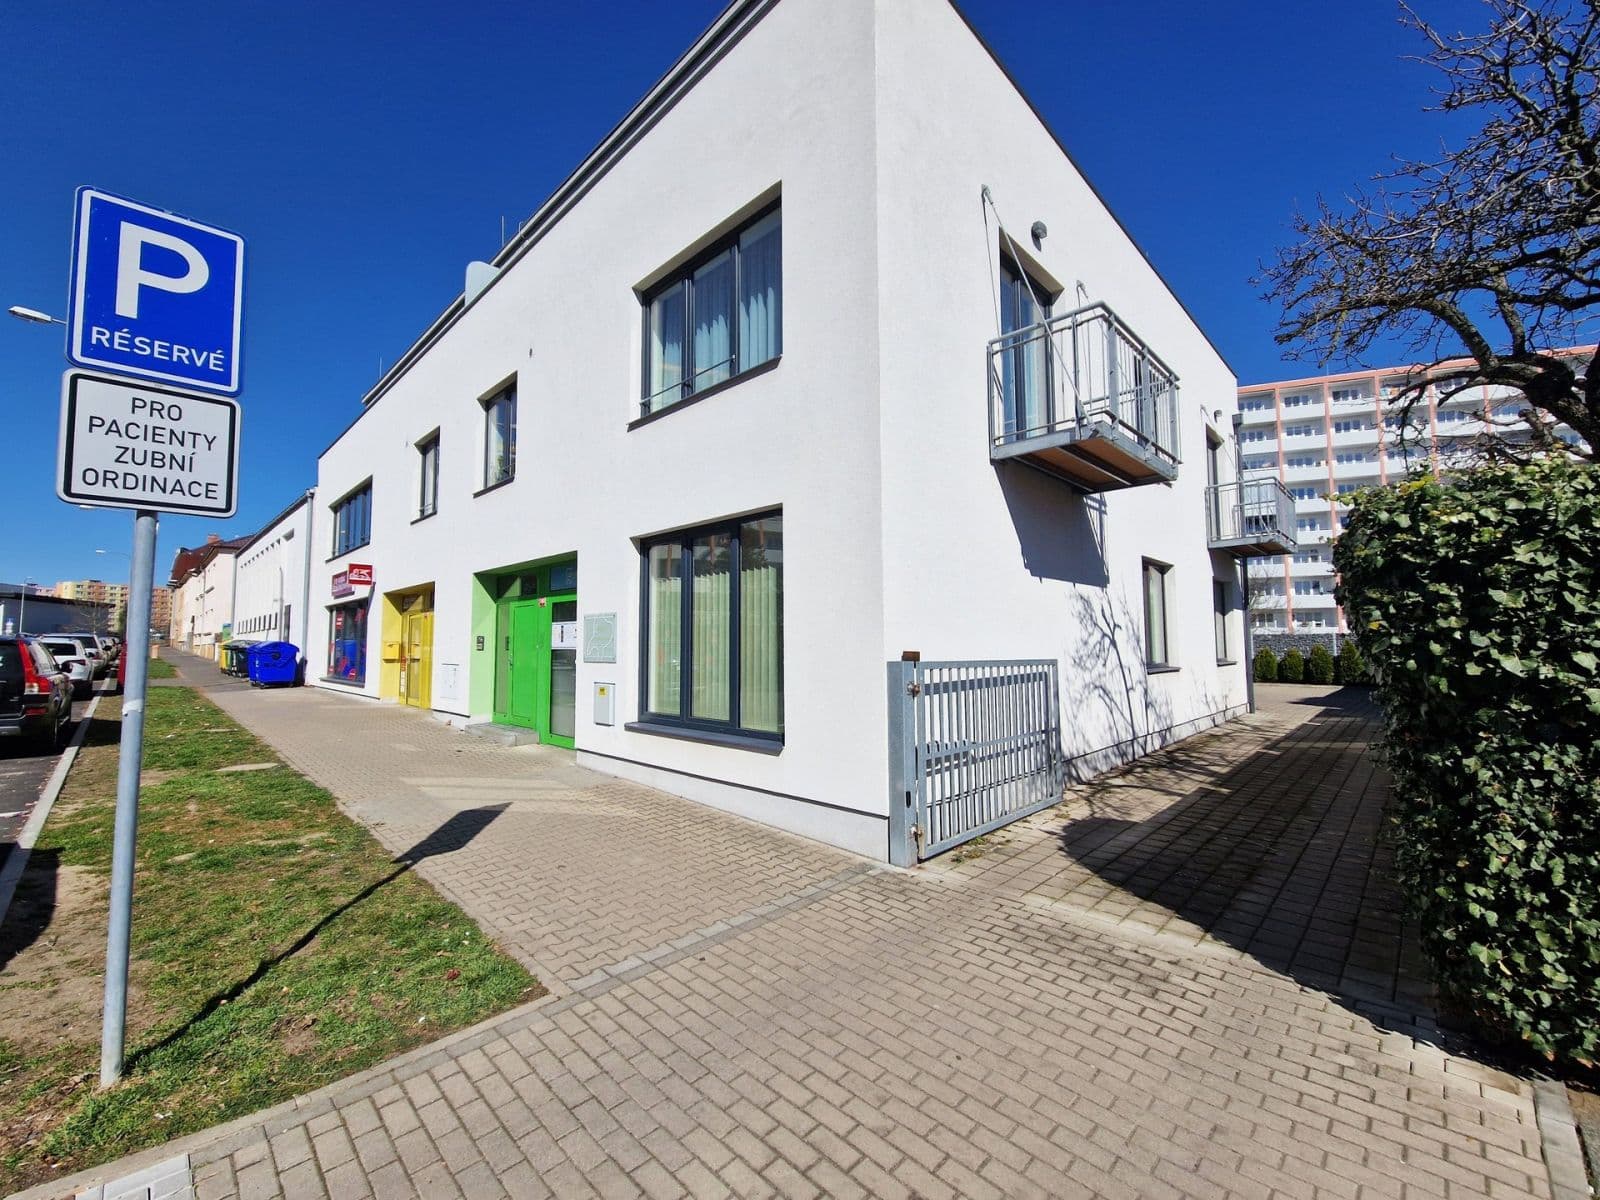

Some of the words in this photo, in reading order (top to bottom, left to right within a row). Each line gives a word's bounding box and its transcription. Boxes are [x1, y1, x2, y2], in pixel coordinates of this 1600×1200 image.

[115, 221, 209, 319] P
[91, 326, 224, 371] RÉSERVÉ
[131, 397, 182, 421] PRO
[89, 416, 217, 451] PACIENTY
[114, 446, 196, 472] ZUBNÍ
[81, 468, 218, 499] ORDINACE
